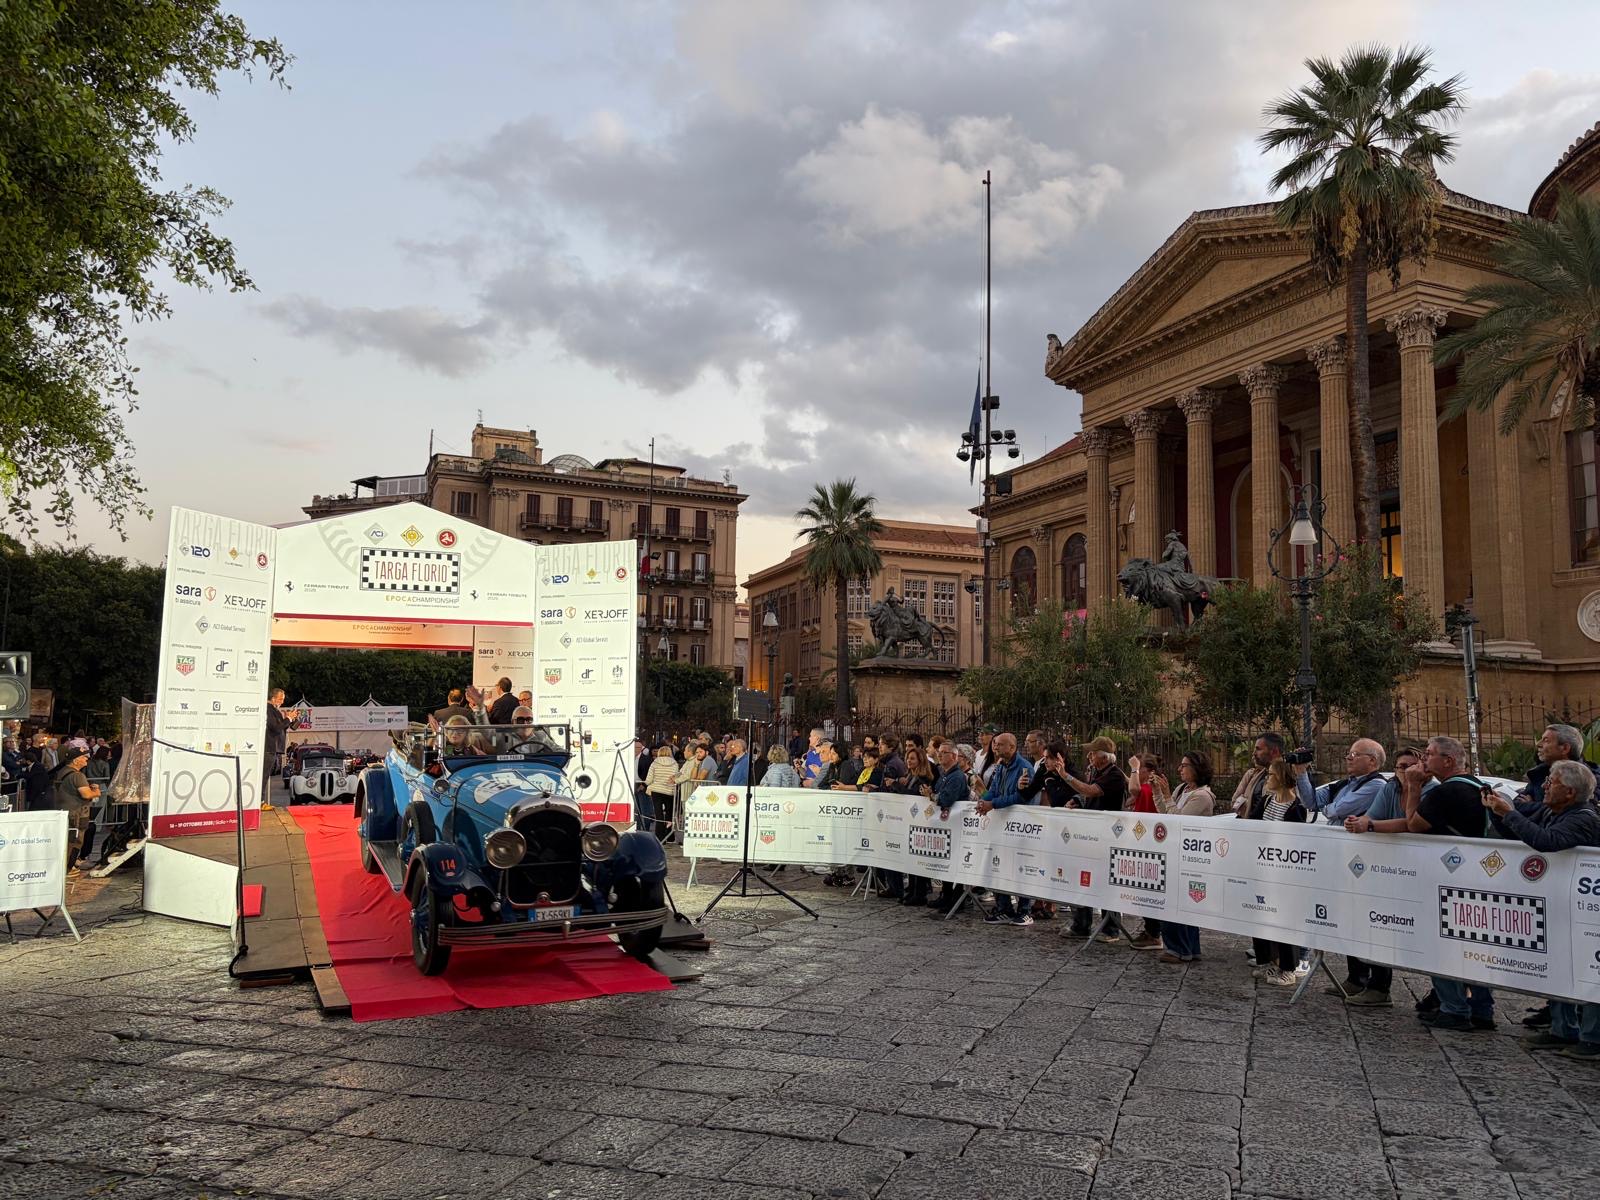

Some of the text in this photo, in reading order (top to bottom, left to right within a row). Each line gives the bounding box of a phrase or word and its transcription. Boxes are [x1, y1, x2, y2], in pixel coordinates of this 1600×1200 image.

[190, 545, 210, 558] 120
[374, 560, 448, 583] TARGA FLORIO
[552, 575, 569, 584] 120
[176, 584, 201, 597] sara
[223, 594, 267, 610] XERJOFF
[541, 609, 563, 618] sara
[584, 609, 628, 619] XERJOFF
[162, 768, 255, 816] 1906
[754, 802, 780, 812] sara
[818, 805, 864, 816] XERJOFF
[691, 820, 732, 832] TARGA FLORIO
[964, 817, 979, 827] sara
[1005, 821, 1043, 834] XERJOFF
[1182, 838, 1212, 853] sara
[1187, 856, 1211, 864] assicura
[1257, 846, 1317, 865] XERJOFF
[1448, 856, 1461, 864] ACI
[441, 860, 456, 871] 114
[1117, 858, 1159, 882] TARGA FLORIO
[1381, 865, 1397, 875] Global
[1398, 868, 1416, 876] Servizi
[8, 870, 47, 881] Cognizant
[1578, 901, 1584, 910] ti
[1369, 910, 1415, 927] Cognizant
[1452, 901, 1532, 936] TARGA FLORIO
